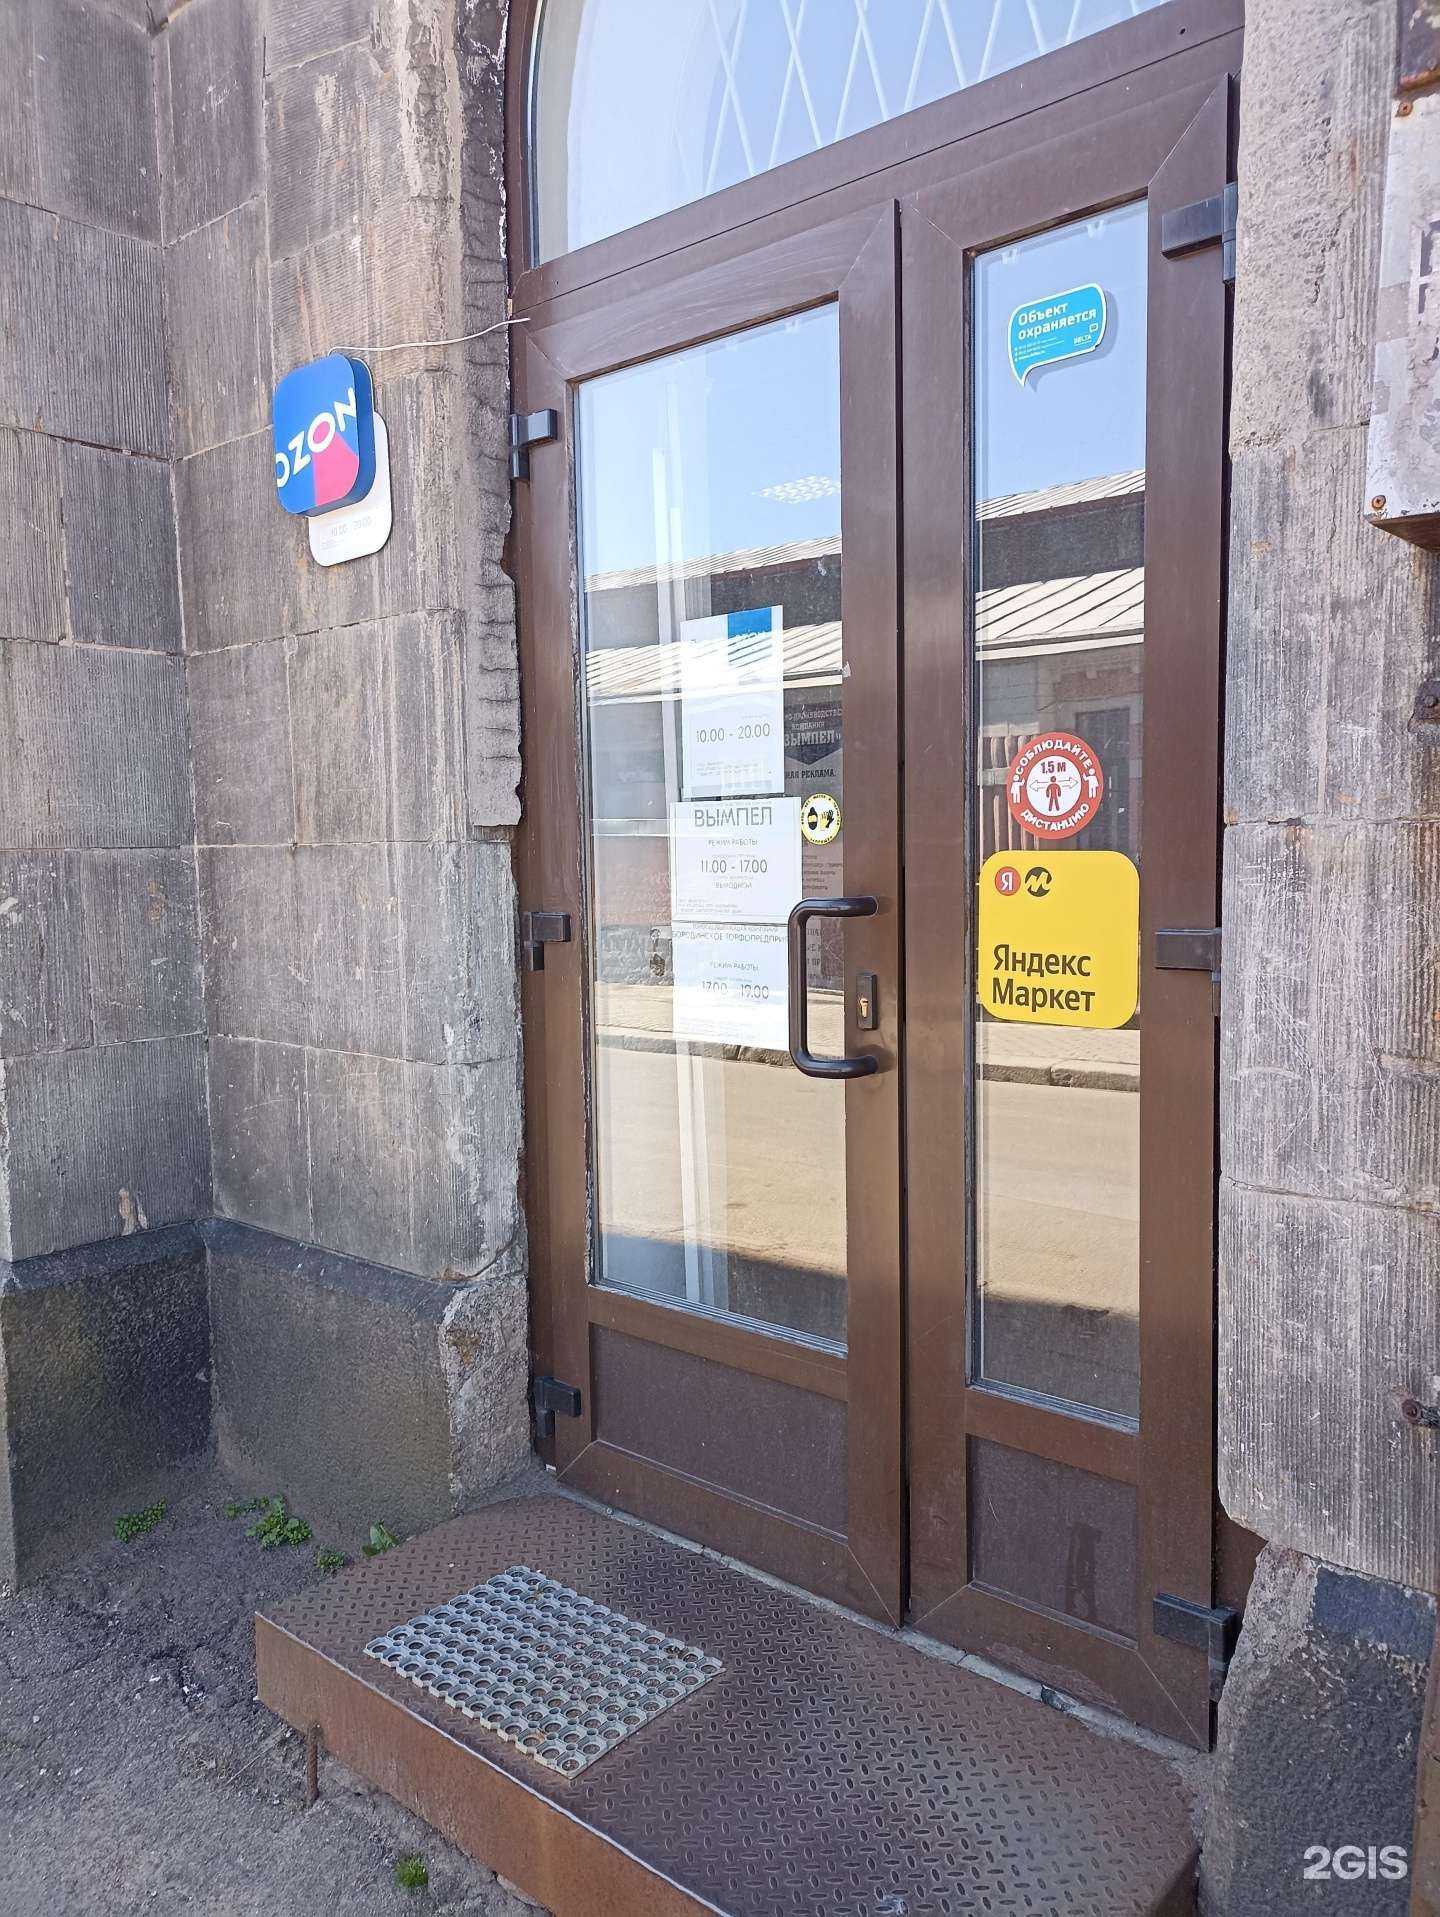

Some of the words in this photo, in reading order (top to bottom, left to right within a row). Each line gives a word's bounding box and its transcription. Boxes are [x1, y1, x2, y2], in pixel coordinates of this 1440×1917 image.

[1018, 302, 1068, 326] Объект
[1018, 308, 1097, 340] охраняется
[275, 387, 357, 488] OZON
[1016, 739, 1093, 775] СОБЛЮДАЙТЕ
[694, 806, 772, 827] ВЫМПЕЛ
[1021, 803, 1090, 832] ДИСТАНЦИЮ
[993, 944, 1091, 977] Яндекс
[992, 977, 1096, 1012] Маркет
